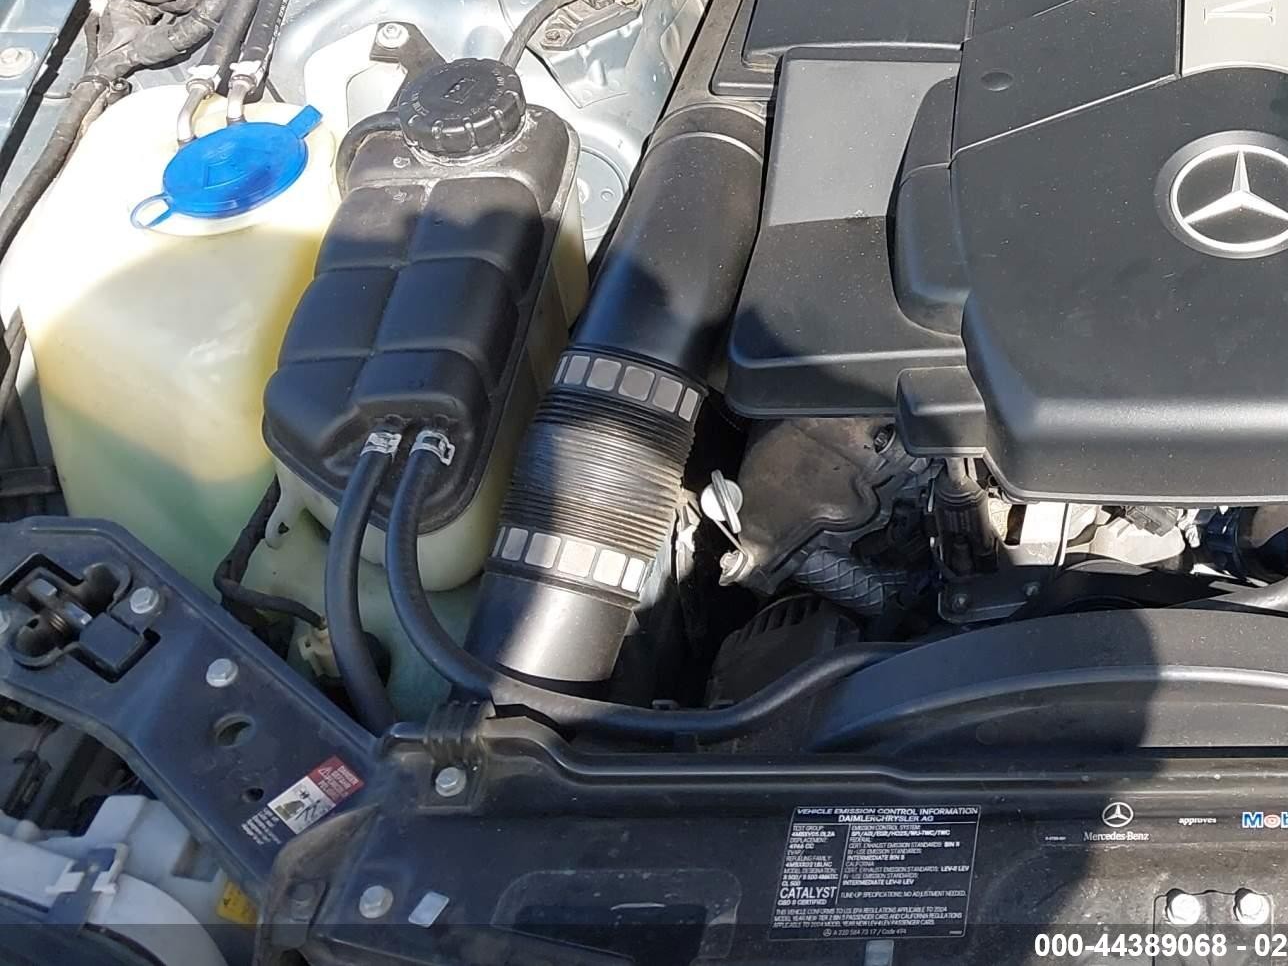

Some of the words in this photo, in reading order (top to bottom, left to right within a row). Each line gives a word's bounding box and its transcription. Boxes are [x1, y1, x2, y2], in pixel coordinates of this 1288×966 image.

[919, 807, 978, 815] INFORMATION
[838, 815, 919, 823] DAIMLERCHRYSLER
[1178, 816, 1217, 826] approves
[1083, 831, 1150, 842] Mercedes-Benz
[780, 886, 838, 899] CATALYST
